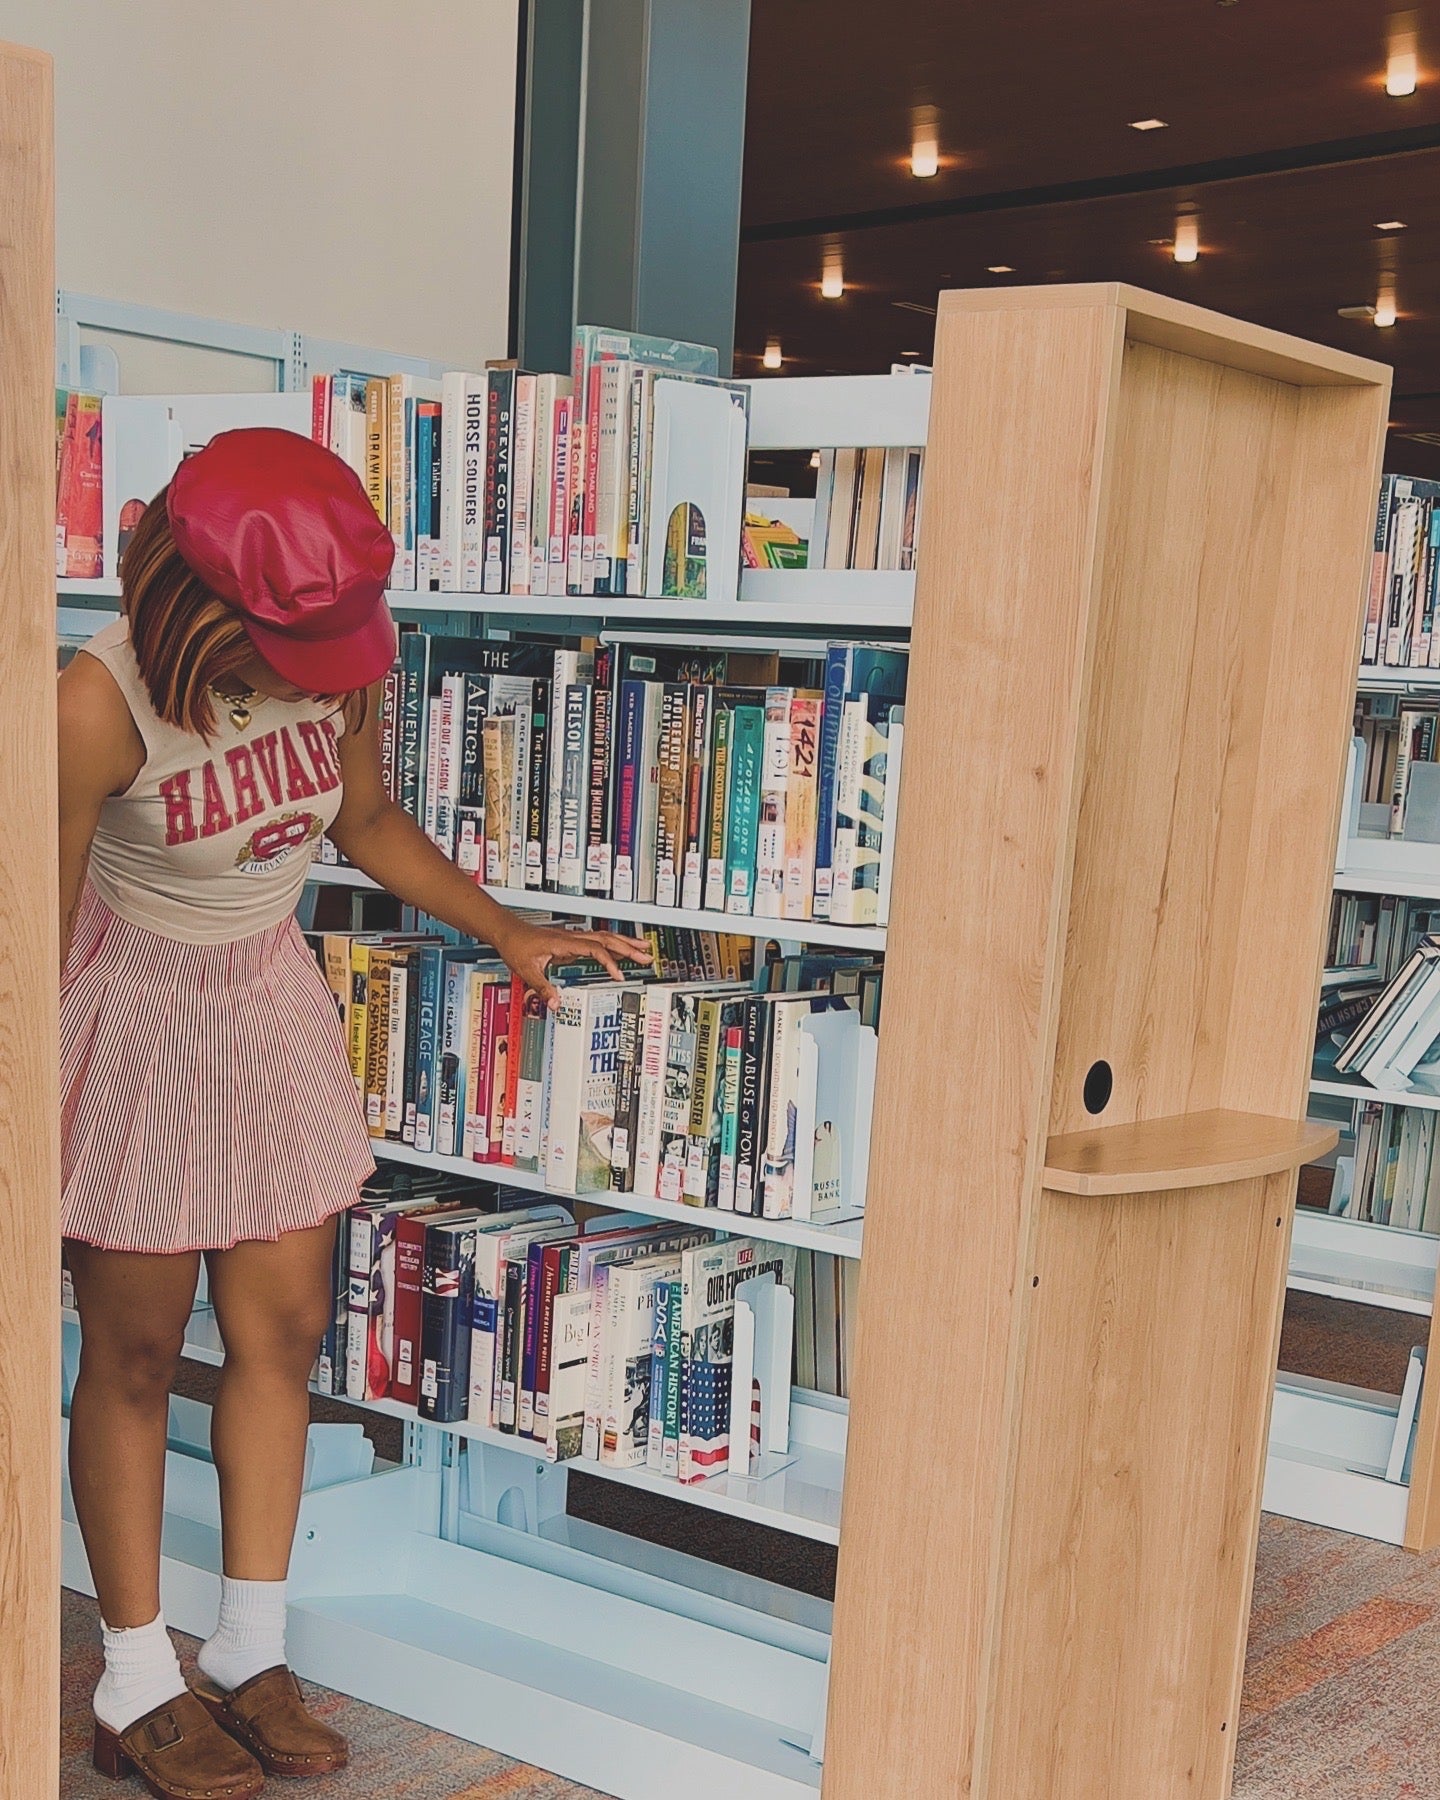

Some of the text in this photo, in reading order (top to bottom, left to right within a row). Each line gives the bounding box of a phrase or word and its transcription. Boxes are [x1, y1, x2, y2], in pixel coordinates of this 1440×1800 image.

[632, 383, 641, 402] WHY
[369, 433, 380, 502] DRAWING
[391, 385, 403, 508] BETHLEHEM
[465, 394, 481, 526] HORSE SOLDIERS
[485, 390, 498, 530] DIRECTORATE
[495, 410, 509, 533] STEVE COLL
[587, 411, 598, 514] HISTORY OF THAILAND
[630, 456, 639, 475] GET
[631, 437, 640, 456] YOU
[431, 458, 441, 497] Taliban
[630, 476, 638, 490] ME
[629, 492, 638, 517] OUT?
[482, 650, 510, 668] THE
[553, 654, 562, 710] MANDELA
[382, 678, 394, 764] LAST MEN
[404, 671, 418, 787] THE VIETNAM
[442, 688, 453, 726] GETTING
[464, 680, 487, 766] Africa
[518, 713, 526, 743] BLACK
[566, 691, 583, 752] NELSON
[594, 689, 610, 745] ENCYCLOPEDIA
[660, 695, 672, 767] CONTINENT
[694, 718, 704, 738] Crazy
[695, 693, 705, 718] Killing
[822, 662, 845, 780] Columbus
[441, 728, 452, 745] OUT
[593, 747, 605, 757] OF
[626, 711, 634, 760] BLACKHAWK
[669, 692, 684, 771] INDIGENOUS
[694, 738, 703, 759] Horse
[792, 719, 815, 778] 1421
[843, 712, 853, 773] SHIPWRECKED
[439, 758, 450, 791] SAIGON
[530, 733, 544, 837] THE HISTORY OF SOUTH
[591, 758, 606, 786] NATIVE
[623, 764, 634, 778] THE
[849, 734, 859, 785] CATALOGUE
[590, 789, 604, 829] AMERICAN
[621, 780, 633, 832] REDISCOVERY
[711, 746, 725, 858] THE DISCOVERERS OF AMER
[732, 778, 743, 843] STRANGE
[740, 743, 754, 856] A VOYAGE LONG
[620, 833, 632, 843] OF
[664, 832, 675, 860] PEKK
[419, 1000, 434, 1062] ICE AGE
[445, 979, 456, 1048] OAK ISLAND
[646, 1010, 663, 1044] FATAL
[776, 1009, 785, 1041] BANKS
[1338, 998, 1369, 1021] CRASH
[367, 989, 380, 1088] & SPANIARDS
[407, 1014, 417, 1070] WOUNDED
[470, 1009, 482, 1064] The Mexican
[625, 1013, 637, 1063] BAY OF PIGS
[645, 1044, 661, 1078] GLORY
[668, 1047, 692, 1064] ABYSS
[376, 1053, 387, 1097] GODS
[692, 1010, 711, 1126] THE BRILLIANT DISASTER
[724, 1058, 738, 1116] HAVANA
[739, 1006, 757, 1165] KUTLER ABUSE OF POW
[399, 1254, 420, 1265] AMERICAN
[400, 1262, 418, 1271] HISTORY
[737, 1250, 753, 1264] LIFE
[528, 1293, 536, 1325] AMERICAN
[541, 1262, 555, 1372] HISPANIC AMERICAN VOICES
[611, 1277, 620, 1328] PROMISED
[654, 1287, 669, 1343] USA
[706, 1277, 725, 1307] OUR
[564, 1322, 584, 1347] Big
[591, 1273, 604, 1380] AMERICAN SPIRIT
[666, 1299, 681, 1429] AMERICAN HISTORY
